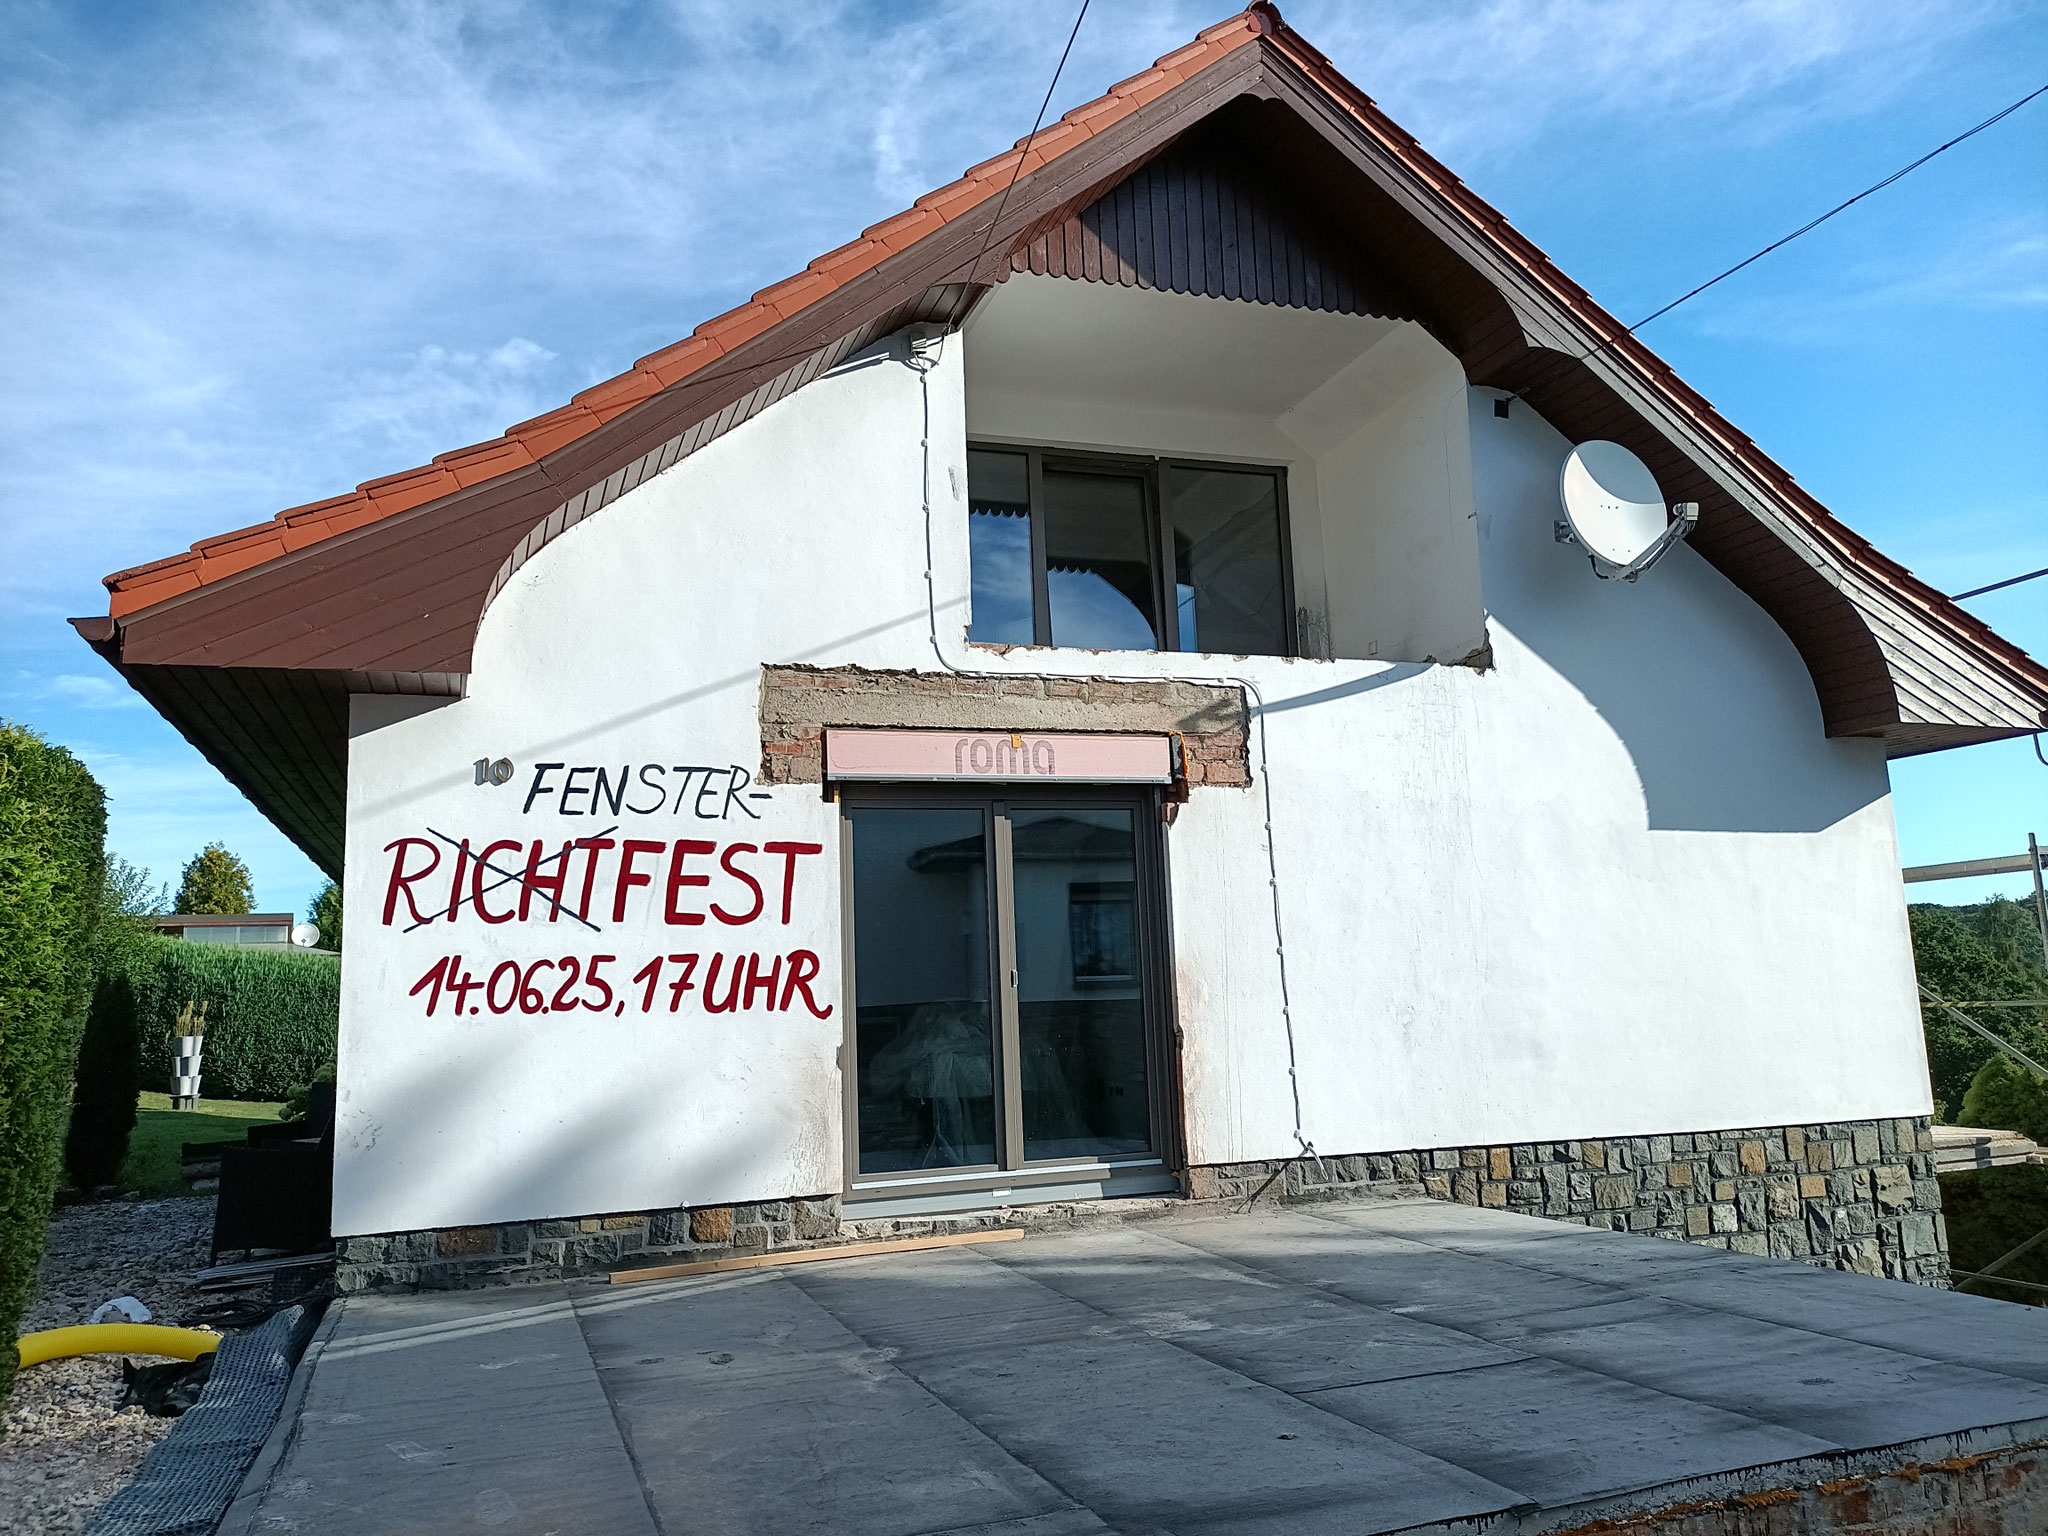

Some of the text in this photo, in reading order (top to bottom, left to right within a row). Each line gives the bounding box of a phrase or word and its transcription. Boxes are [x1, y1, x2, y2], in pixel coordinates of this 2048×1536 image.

[473, 757, 514, 786] 10
[955, 738, 1055, 775] roma
[522, 763, 773, 819] FENSTER-
[382, 837, 823, 926] RICHTFEST
